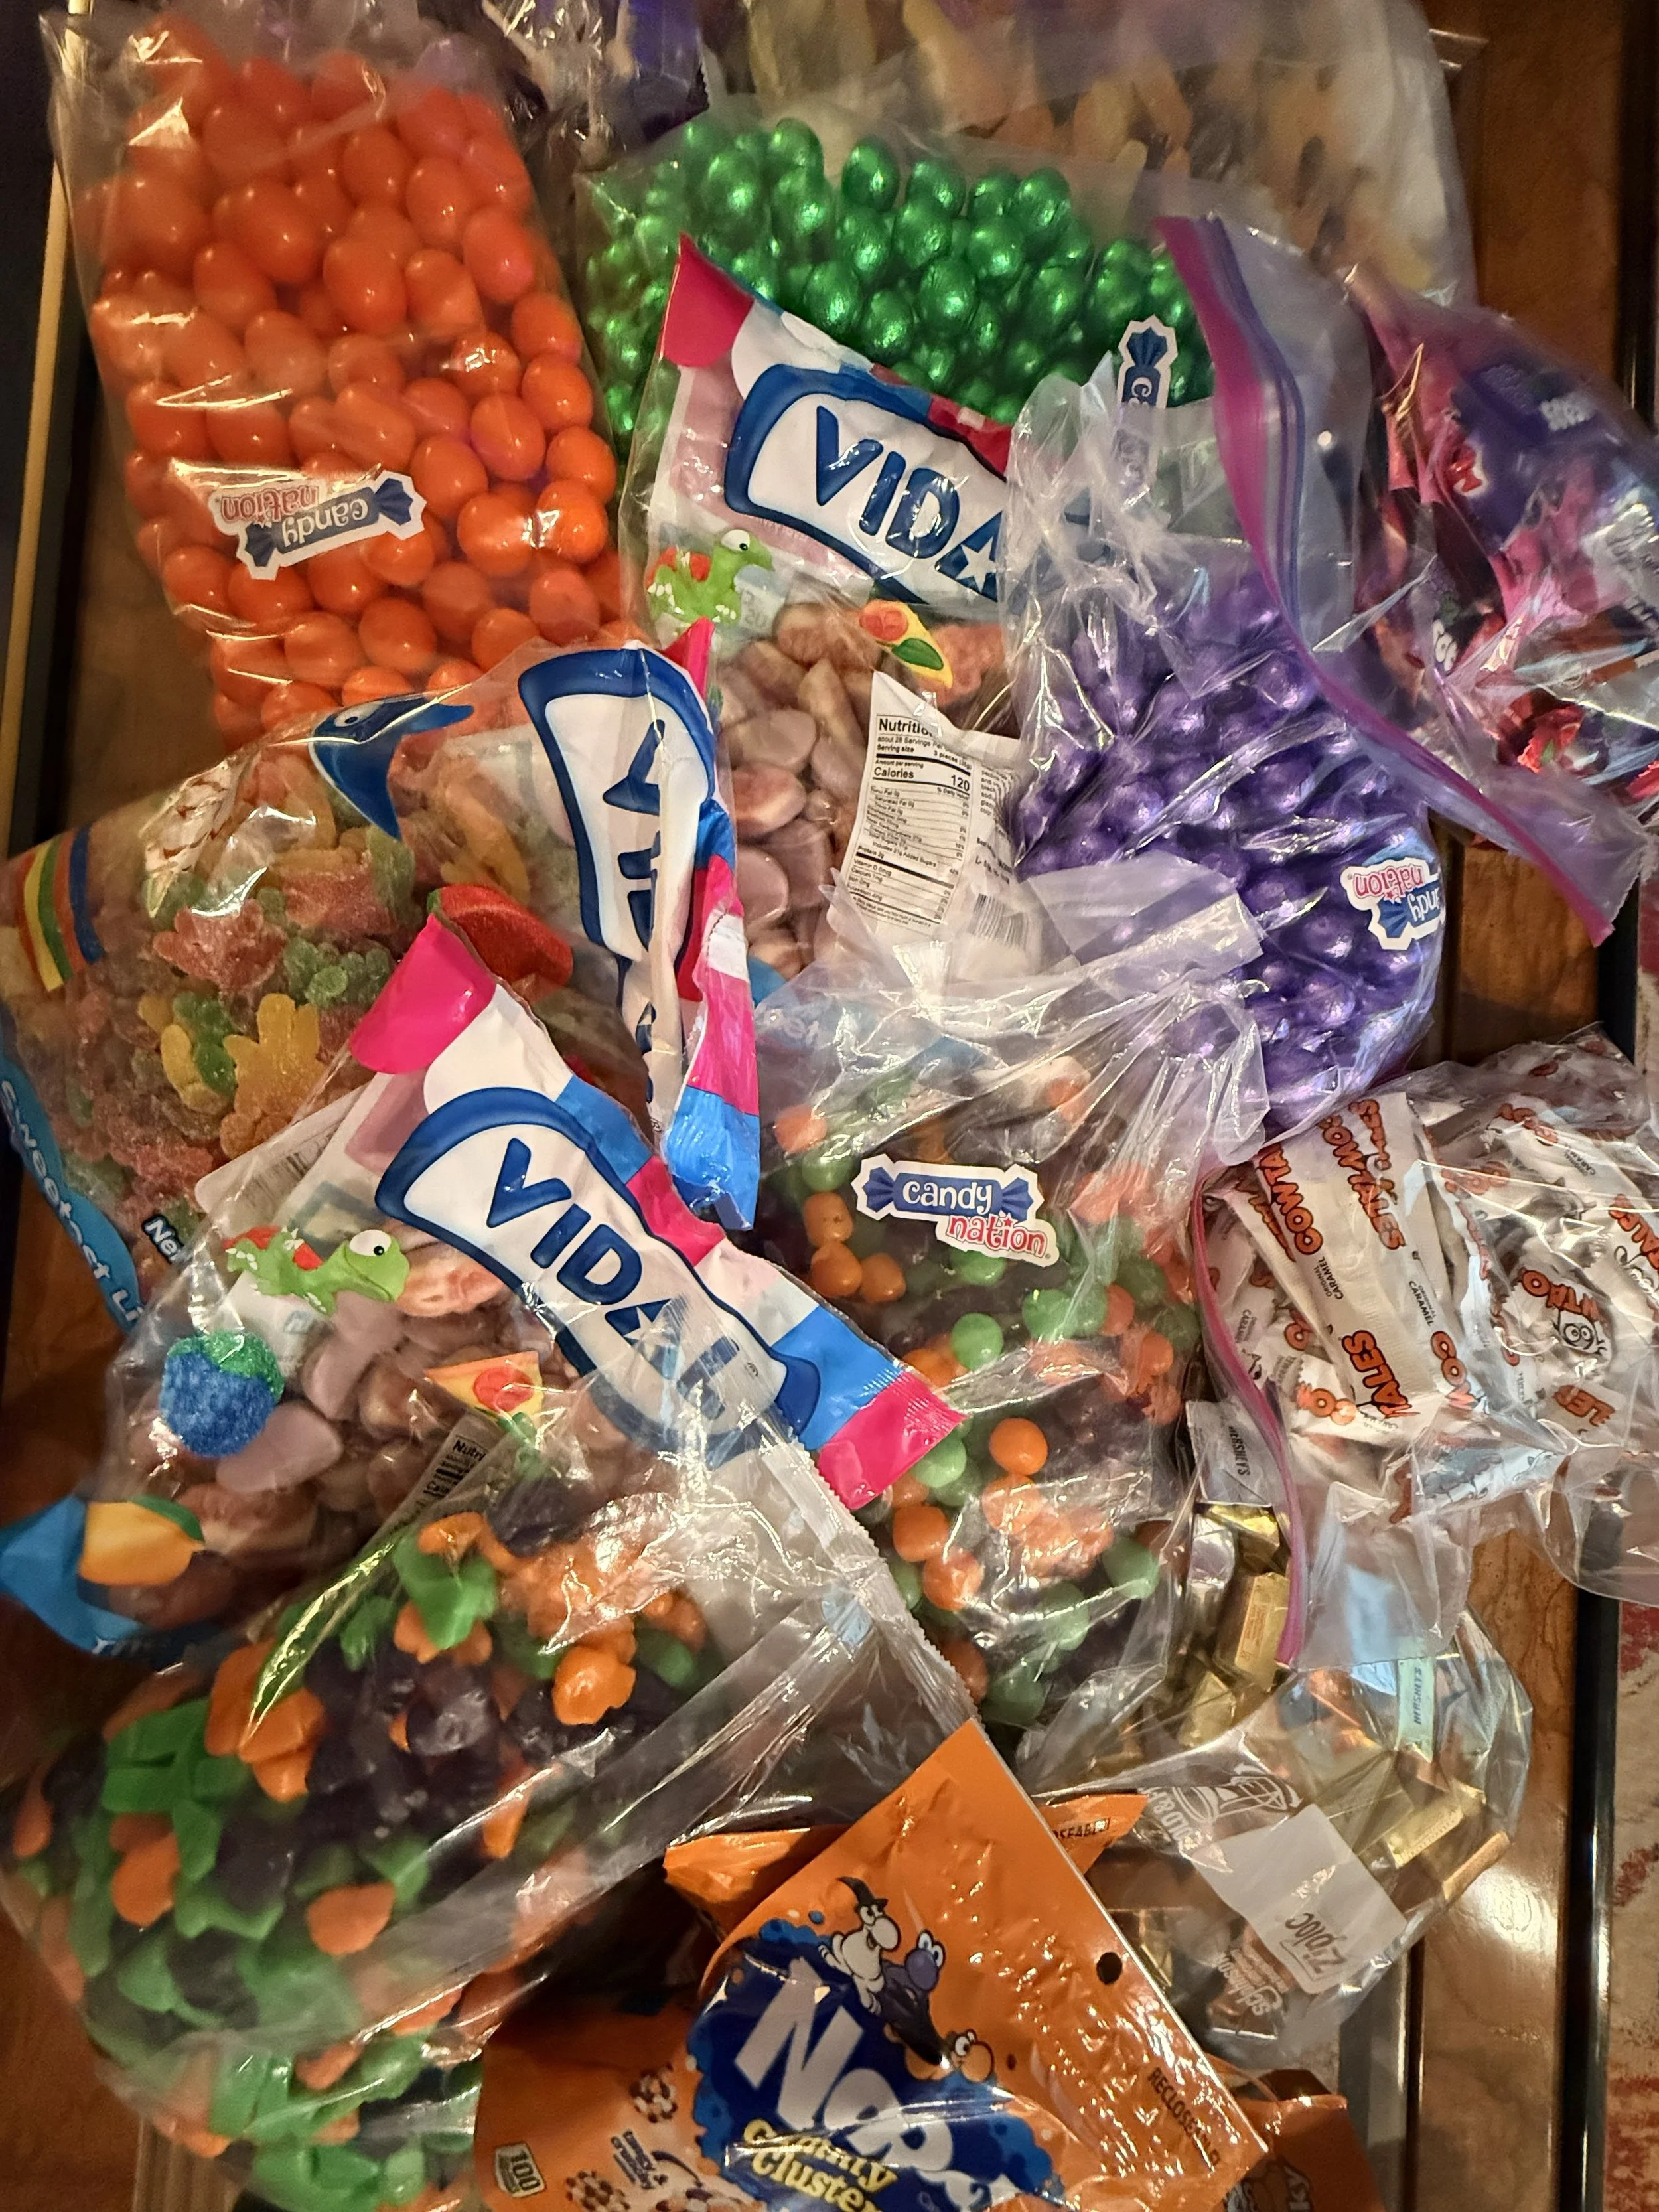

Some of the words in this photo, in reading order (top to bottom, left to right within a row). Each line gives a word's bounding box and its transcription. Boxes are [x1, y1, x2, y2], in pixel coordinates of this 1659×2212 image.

[220, 486, 319, 527] nation
[282, 498, 368, 547] candy
[816, 406, 1003, 602] VIDA
[879, 718, 932, 737] Nutritio
[877, 744, 899, 753] Serving
[874, 767, 914, 778] Calories
[951, 774, 970, 792] 120
[1355, 865, 1423, 898] nation
[1407, 887, 1439, 922] ndy
[902, 1181, 992, 1214] candy
[947, 1214, 1046, 1257] nation
[1318, 1256, 1344, 1300] CARAMEL
[1409, 1280, 1434, 1326] CARAMEL
[1285, 1912, 1348, 1974] Ziploc
[510, 2151, 541, 2191] 100
